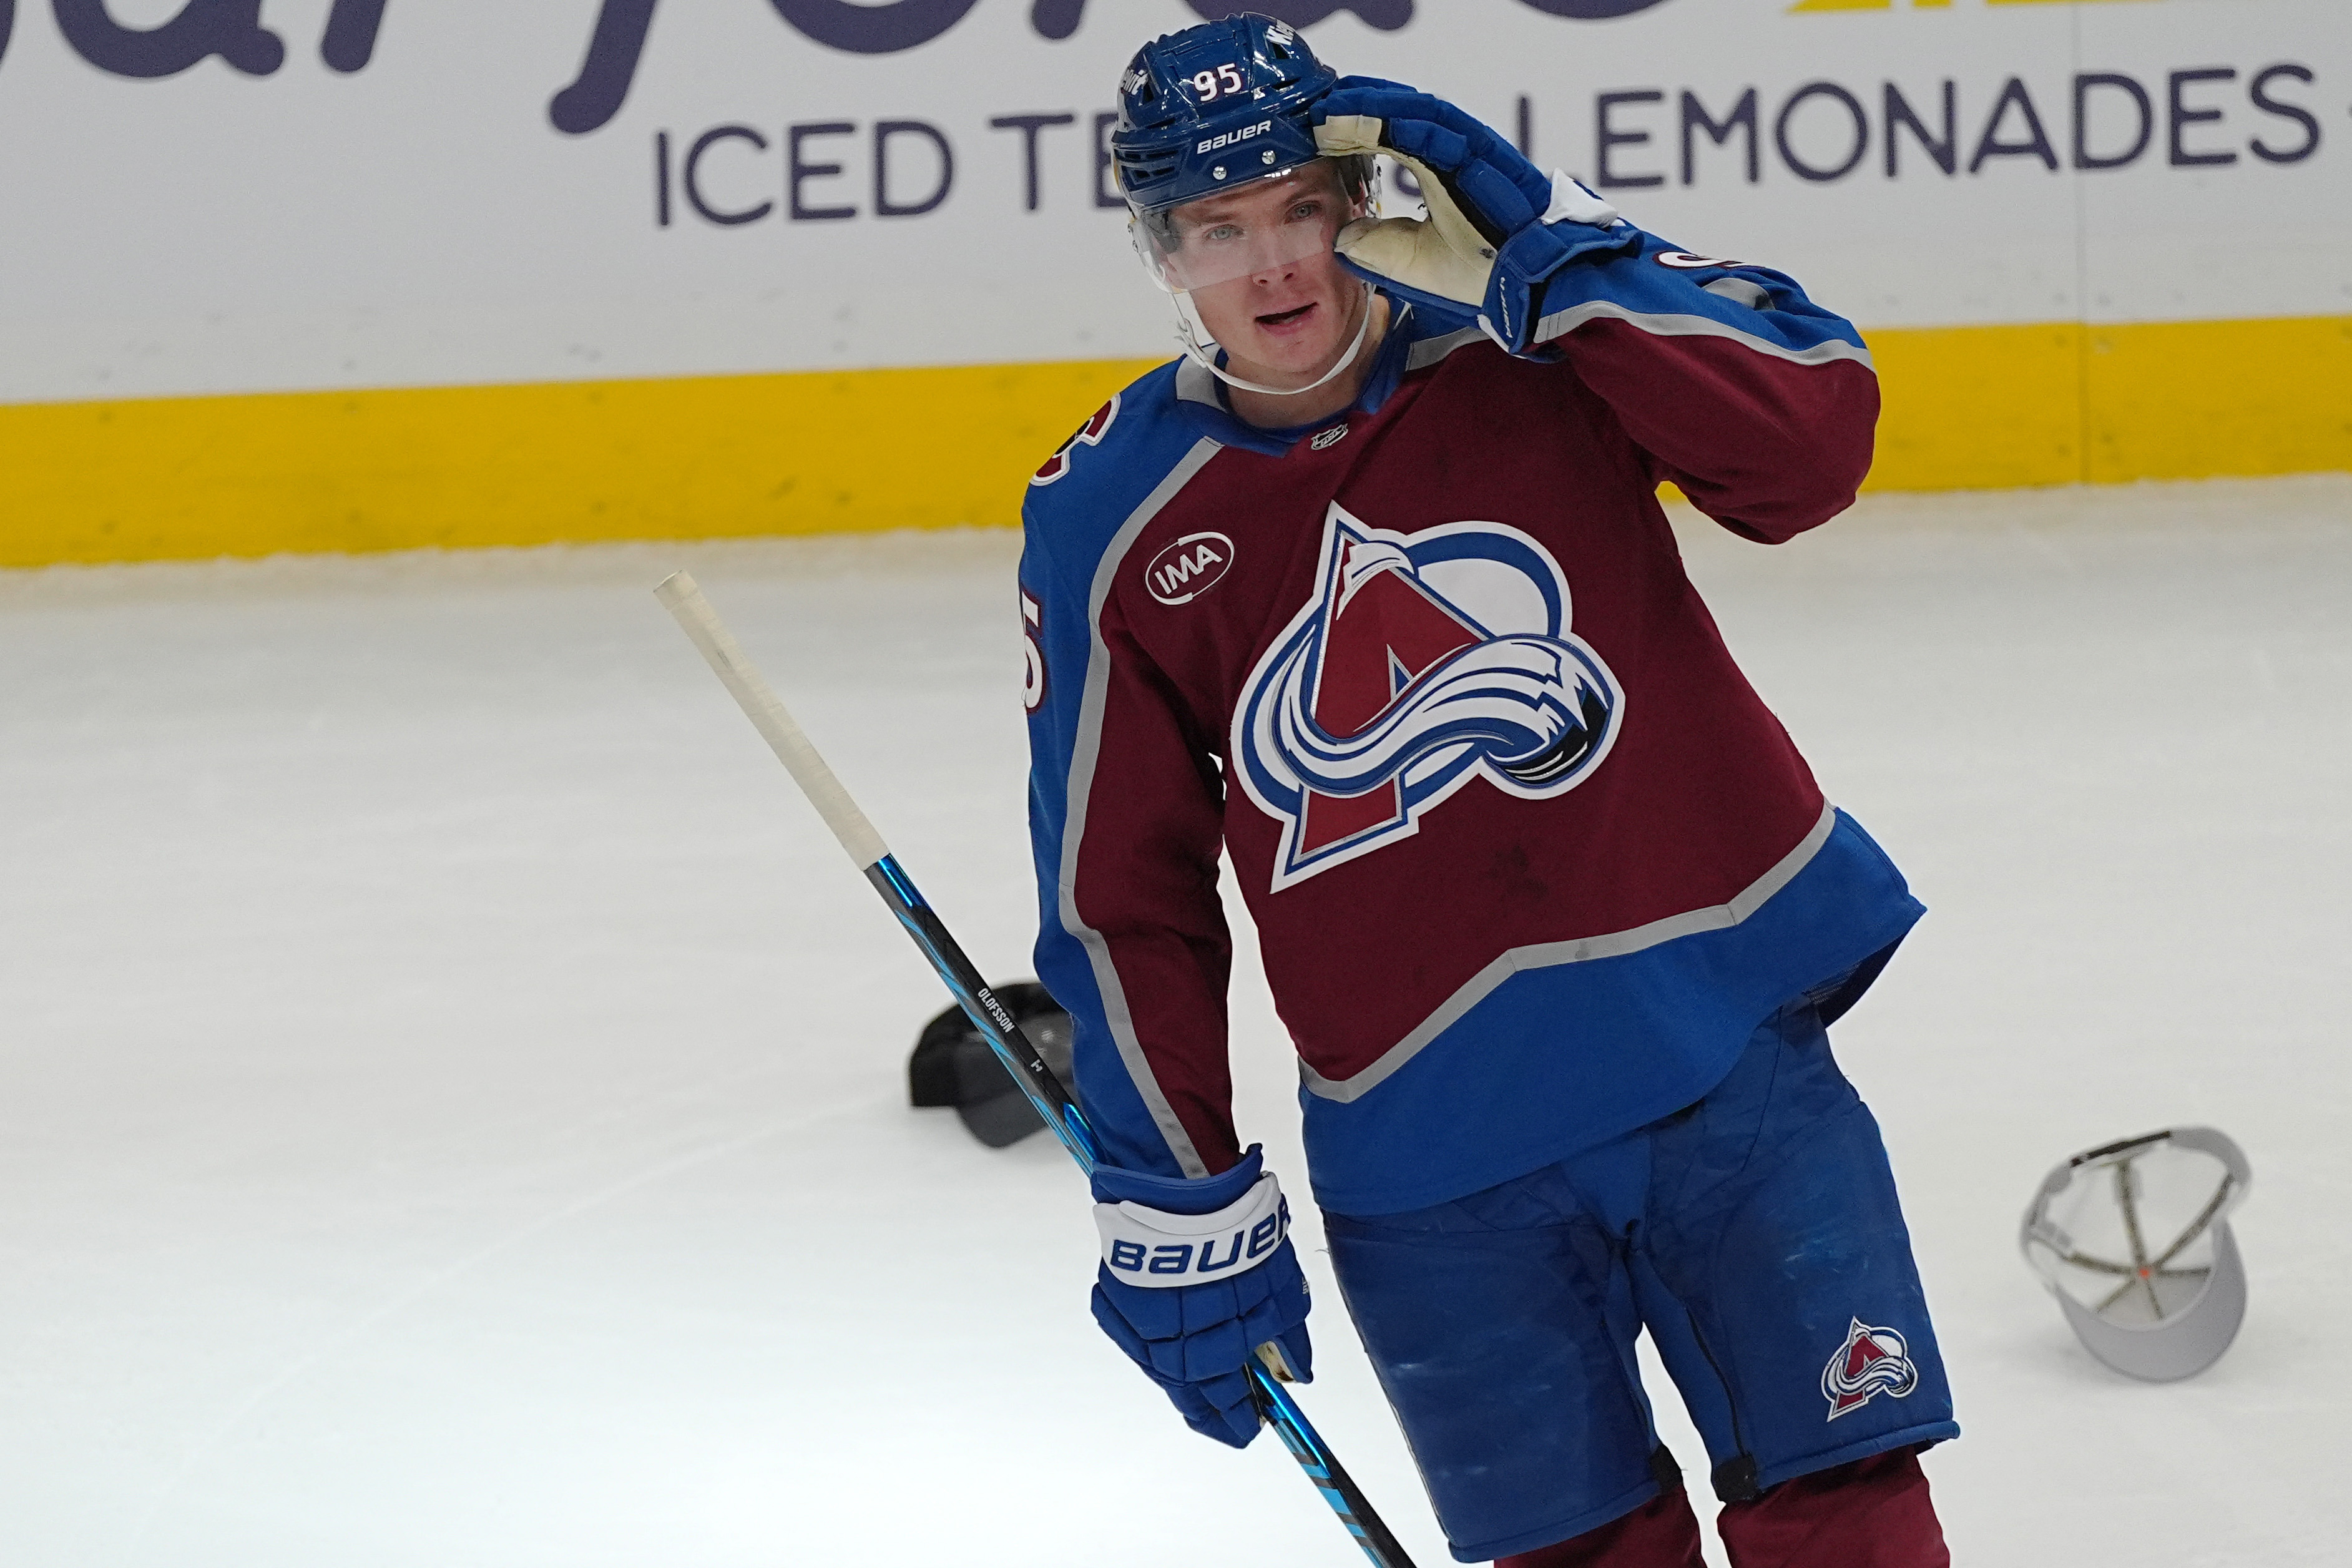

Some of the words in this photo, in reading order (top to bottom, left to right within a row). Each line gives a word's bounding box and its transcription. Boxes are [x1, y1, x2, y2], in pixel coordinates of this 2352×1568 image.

[1193, 62, 1243, 102] 95
[1197, 120, 1272, 155] BAUER
[655, 119, 955, 228] ICED
[1155, 544, 1223, 595] IMA
[978, 987, 1015, 1033] OLOFSSON
[1110, 1193, 1291, 1274] BAUER
